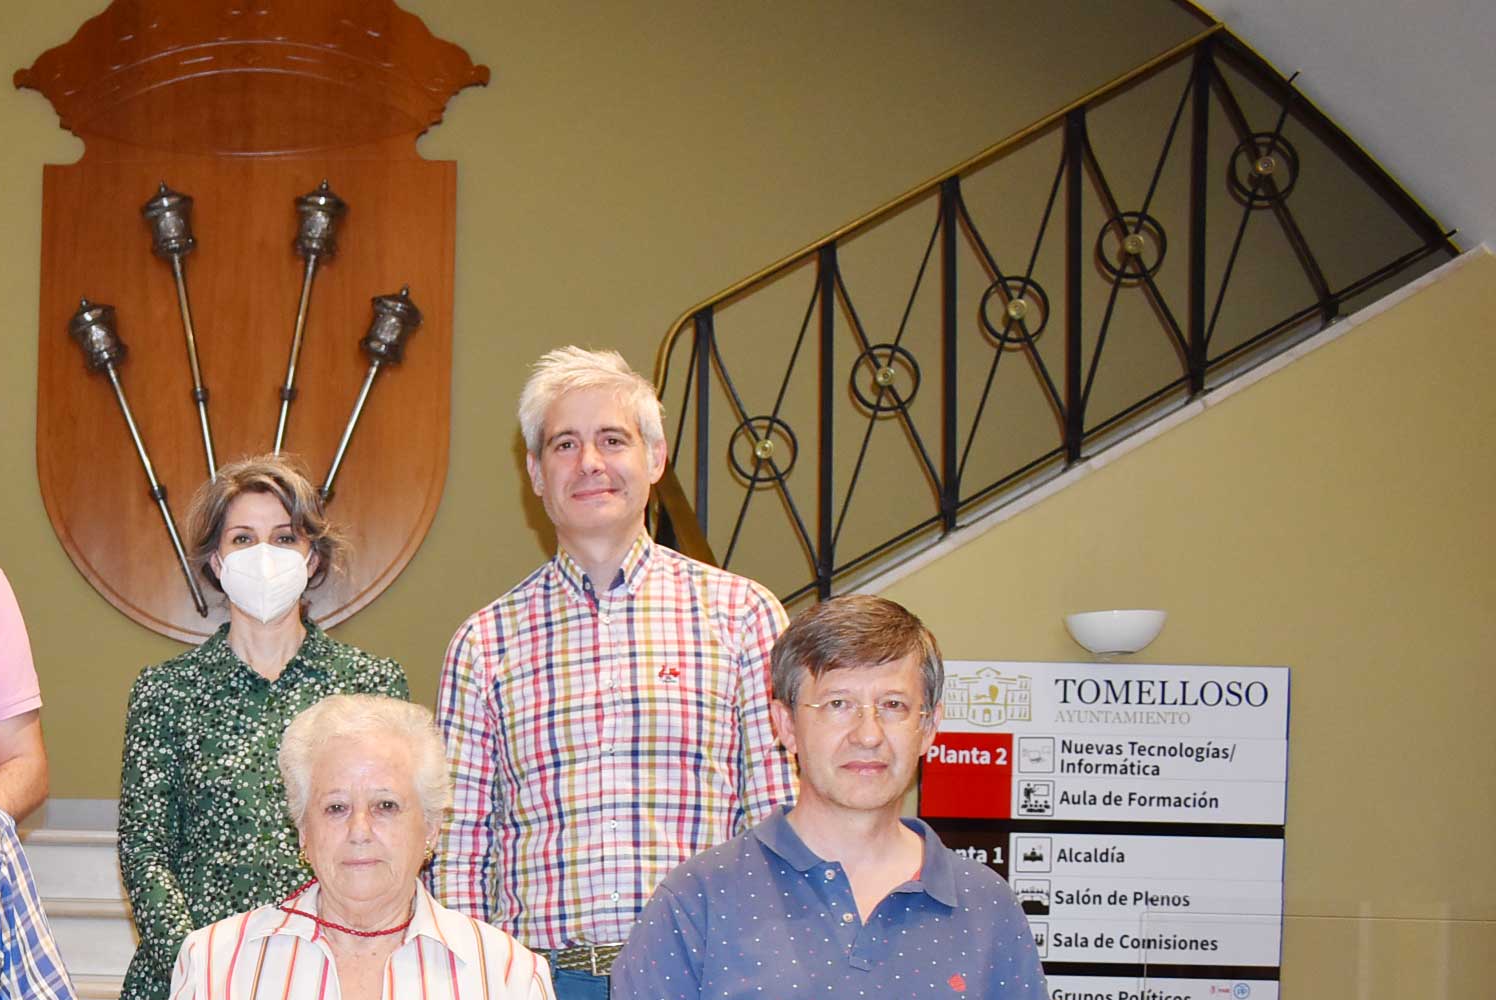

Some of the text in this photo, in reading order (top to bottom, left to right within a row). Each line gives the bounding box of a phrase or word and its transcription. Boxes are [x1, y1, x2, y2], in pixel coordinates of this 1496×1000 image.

[1055, 678, 1268, 708] TOMELLOSO
[1055, 710, 1191, 726] AYUNTAMIENTO
[926, 744, 1008, 765] Planta 2
[1060, 740, 1236, 762] Nuevas Tecnologías/
[1060, 758, 1160, 776] Informática
[1060, 790, 1219, 809] Aula de Formación
[992, 846, 1004, 864] 1
[1056, 848, 1126, 864] Alcaldía
[1054, 889, 1190, 908] Salón de Plenos
[1053, 932, 1218, 951] Sala de Comisiones
